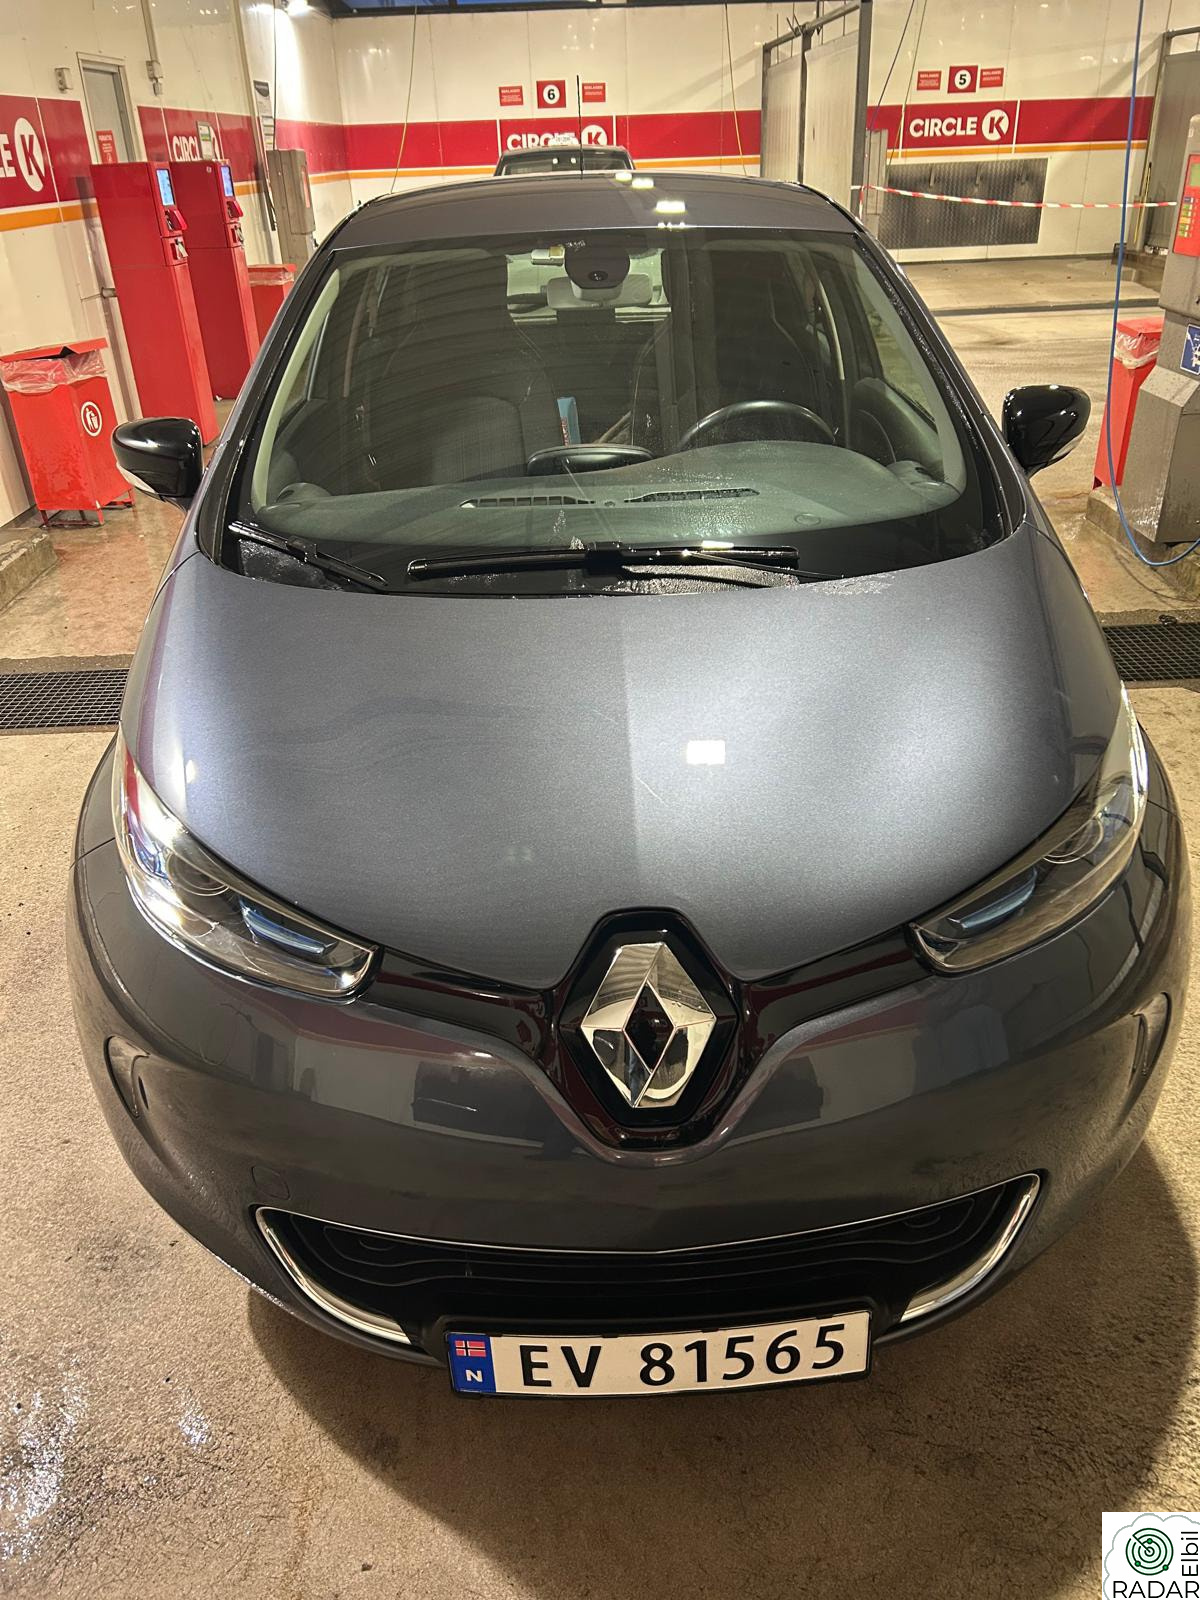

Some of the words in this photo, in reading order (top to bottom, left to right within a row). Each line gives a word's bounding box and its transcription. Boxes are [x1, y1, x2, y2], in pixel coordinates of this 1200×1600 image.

[958, 74, 967, 86] 5
[547, 88, 556, 101] 6
[909, 116, 978, 138] CIRCLE
[987, 114, 1008, 139] K
[18, 131, 45, 184] K
[519, 1344, 602, 1388] EV
[639, 1323, 846, 1386] 81565
[466, 1369, 484, 1383] N
